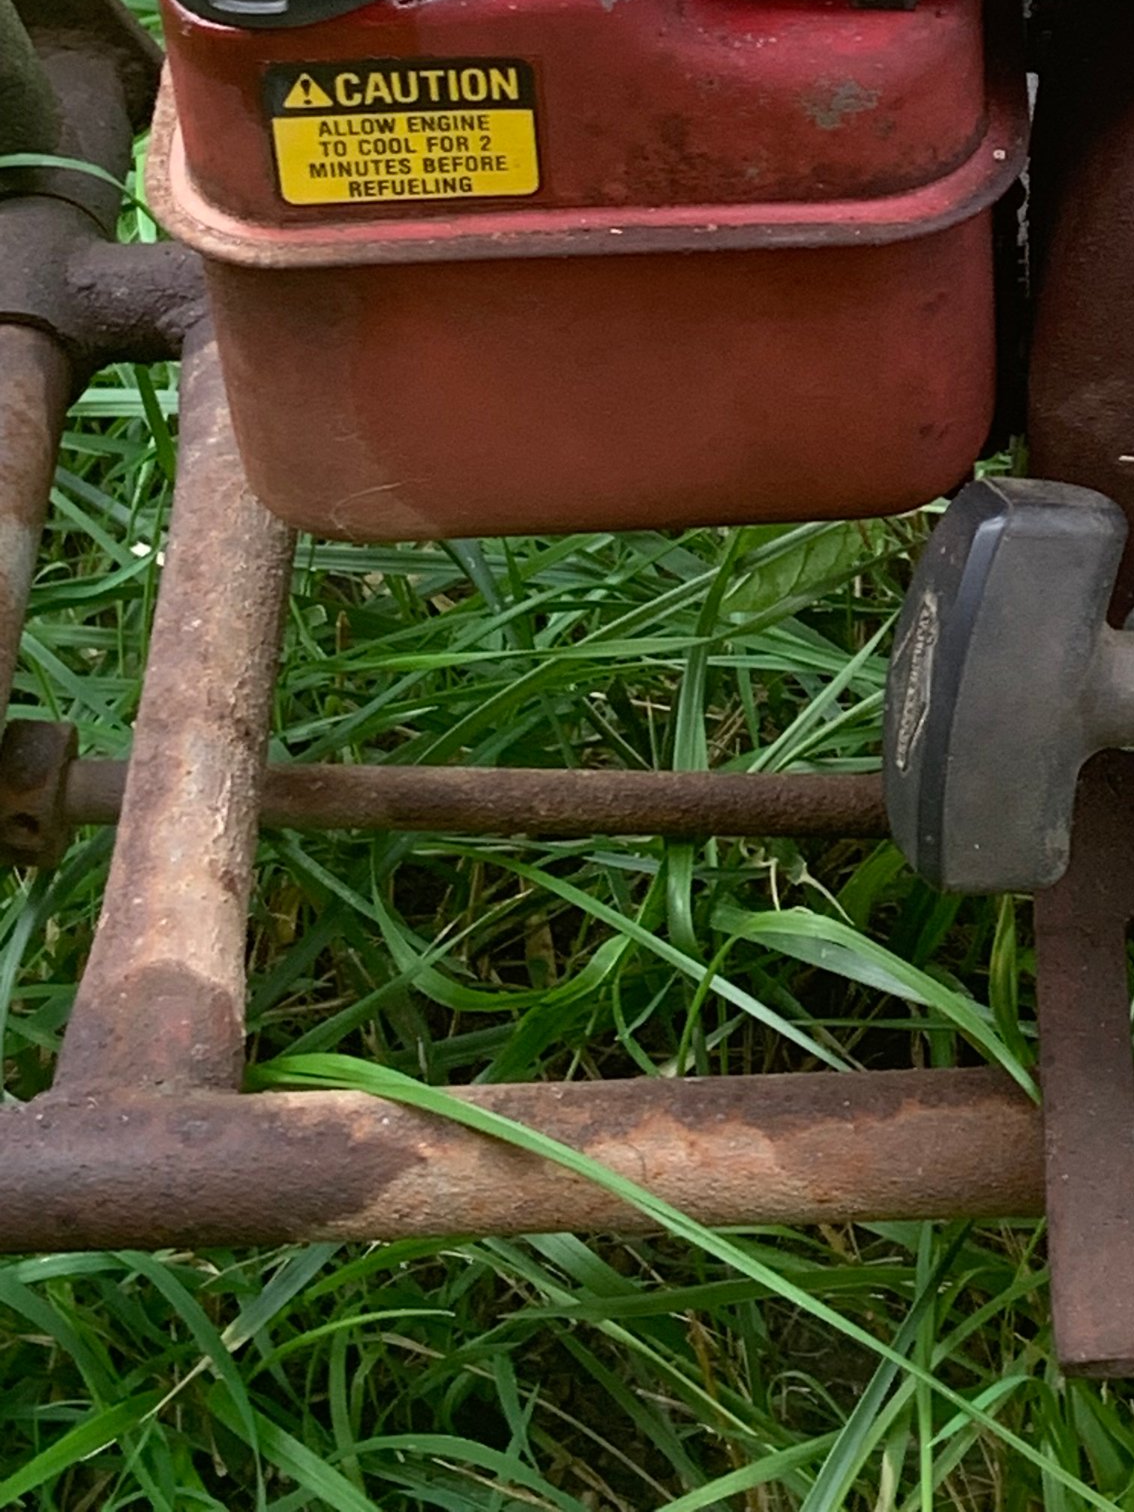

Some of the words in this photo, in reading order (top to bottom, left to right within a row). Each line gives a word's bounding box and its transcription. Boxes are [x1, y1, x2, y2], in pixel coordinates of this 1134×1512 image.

[335, 67, 519, 108] CAUTION
[318, 118, 397, 138] ALLOW
[406, 114, 491, 134] ENGINE
[319, 140, 347, 158] TO
[358, 137, 417, 156] COOL
[426, 136, 470, 154] FOR
[479, 134, 492, 152] 2
[308, 157, 413, 179] MINUTES
[422, 154, 509, 174] BEFORE
[347, 176, 474, 199] REFUELING
